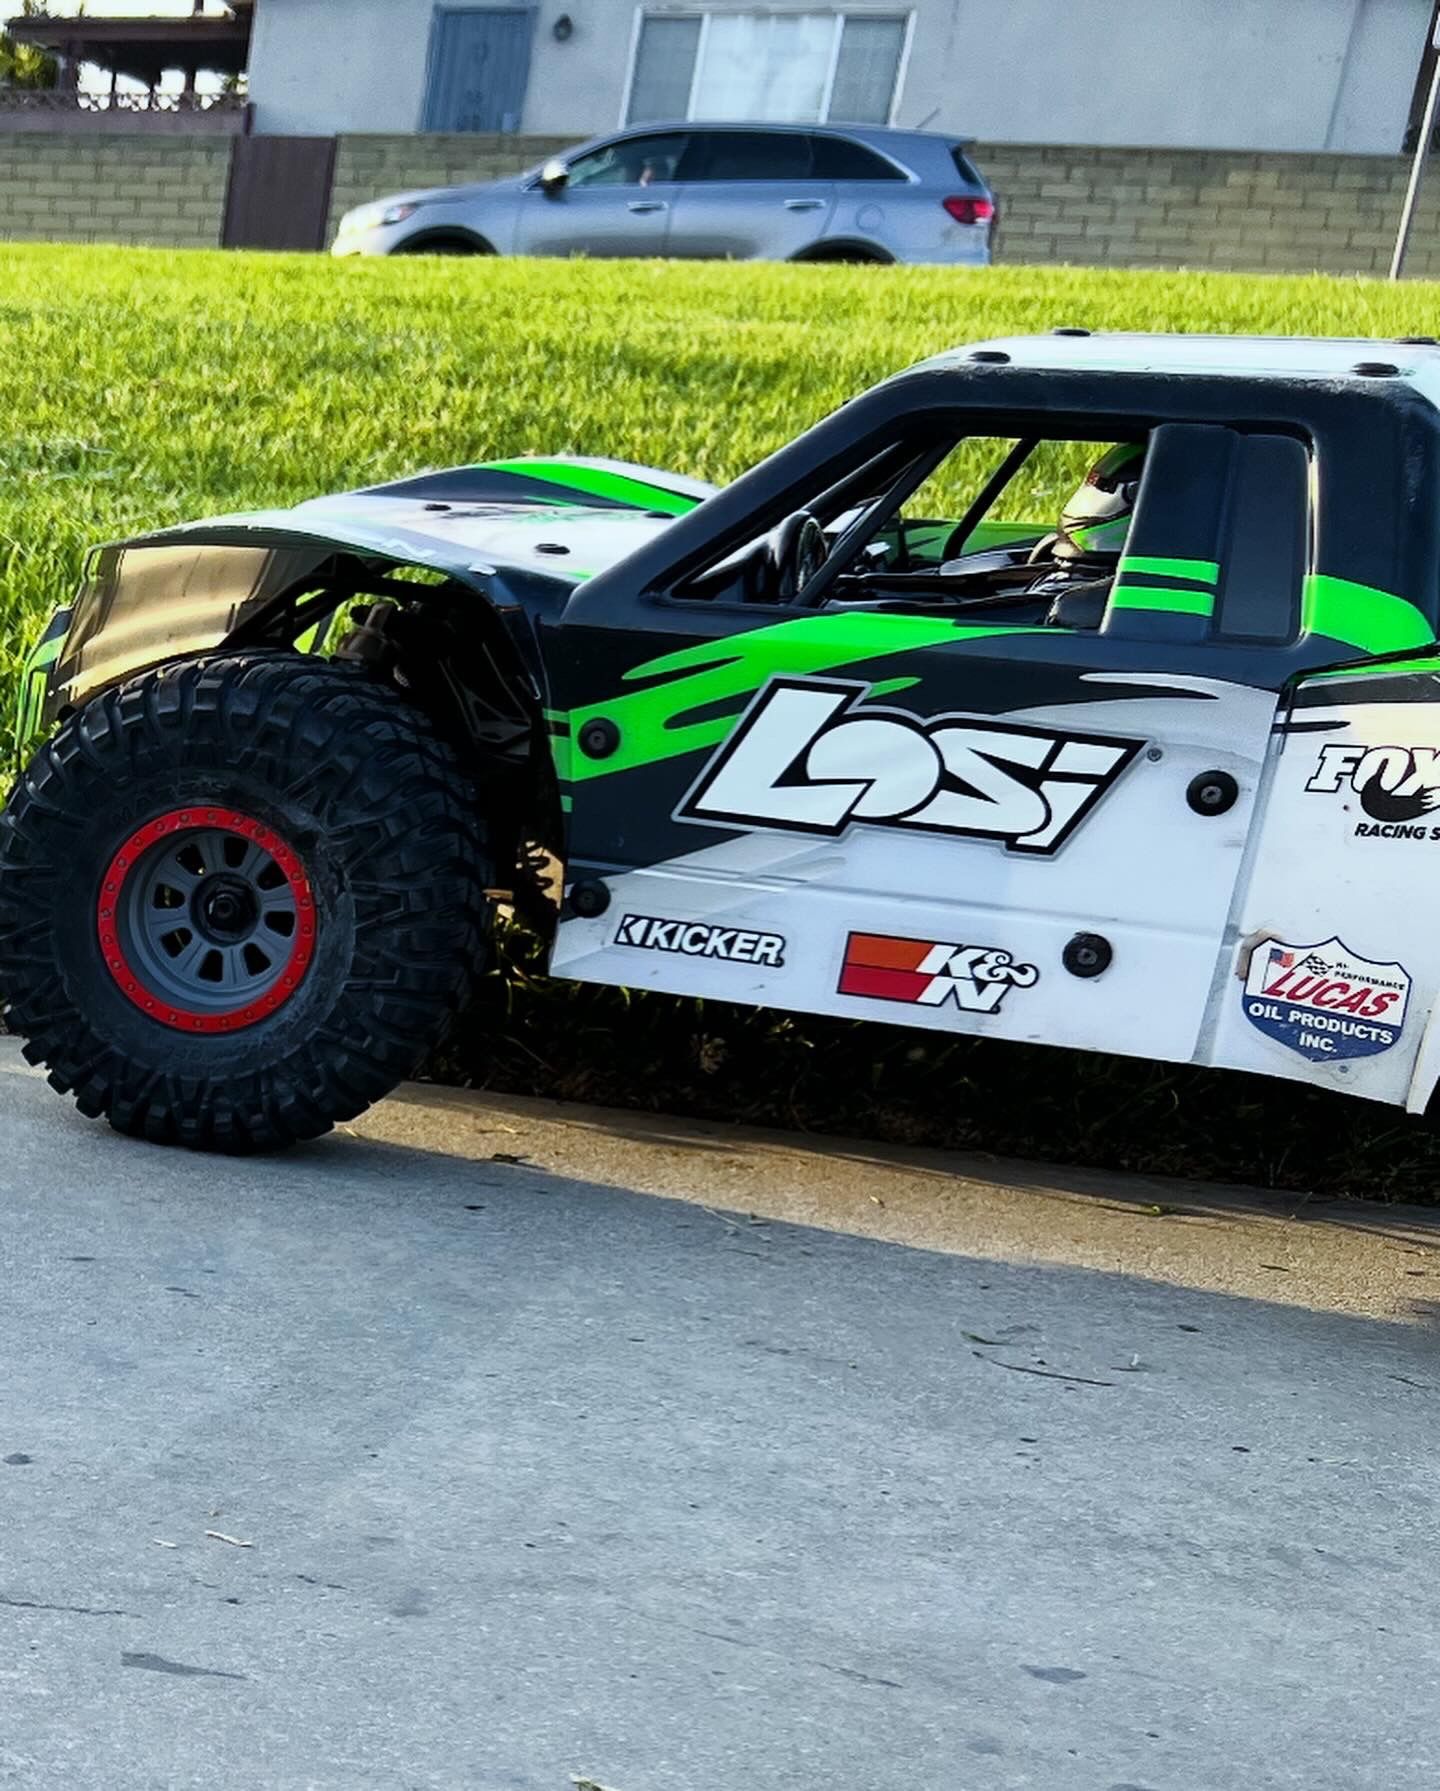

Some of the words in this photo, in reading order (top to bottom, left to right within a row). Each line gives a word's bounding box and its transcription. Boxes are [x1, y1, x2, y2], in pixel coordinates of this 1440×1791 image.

[1304, 744, 1440, 802] FOX
[1355, 822, 1427, 840] RACING
[644, 918, 786, 966] KICKER
[1264, 971, 1400, 1017] LUCAS
[1249, 1002, 1283, 1020] OIL
[1288, 1010, 1393, 1045] PRODUCTS
[1299, 1032, 1338, 1053] INC.
